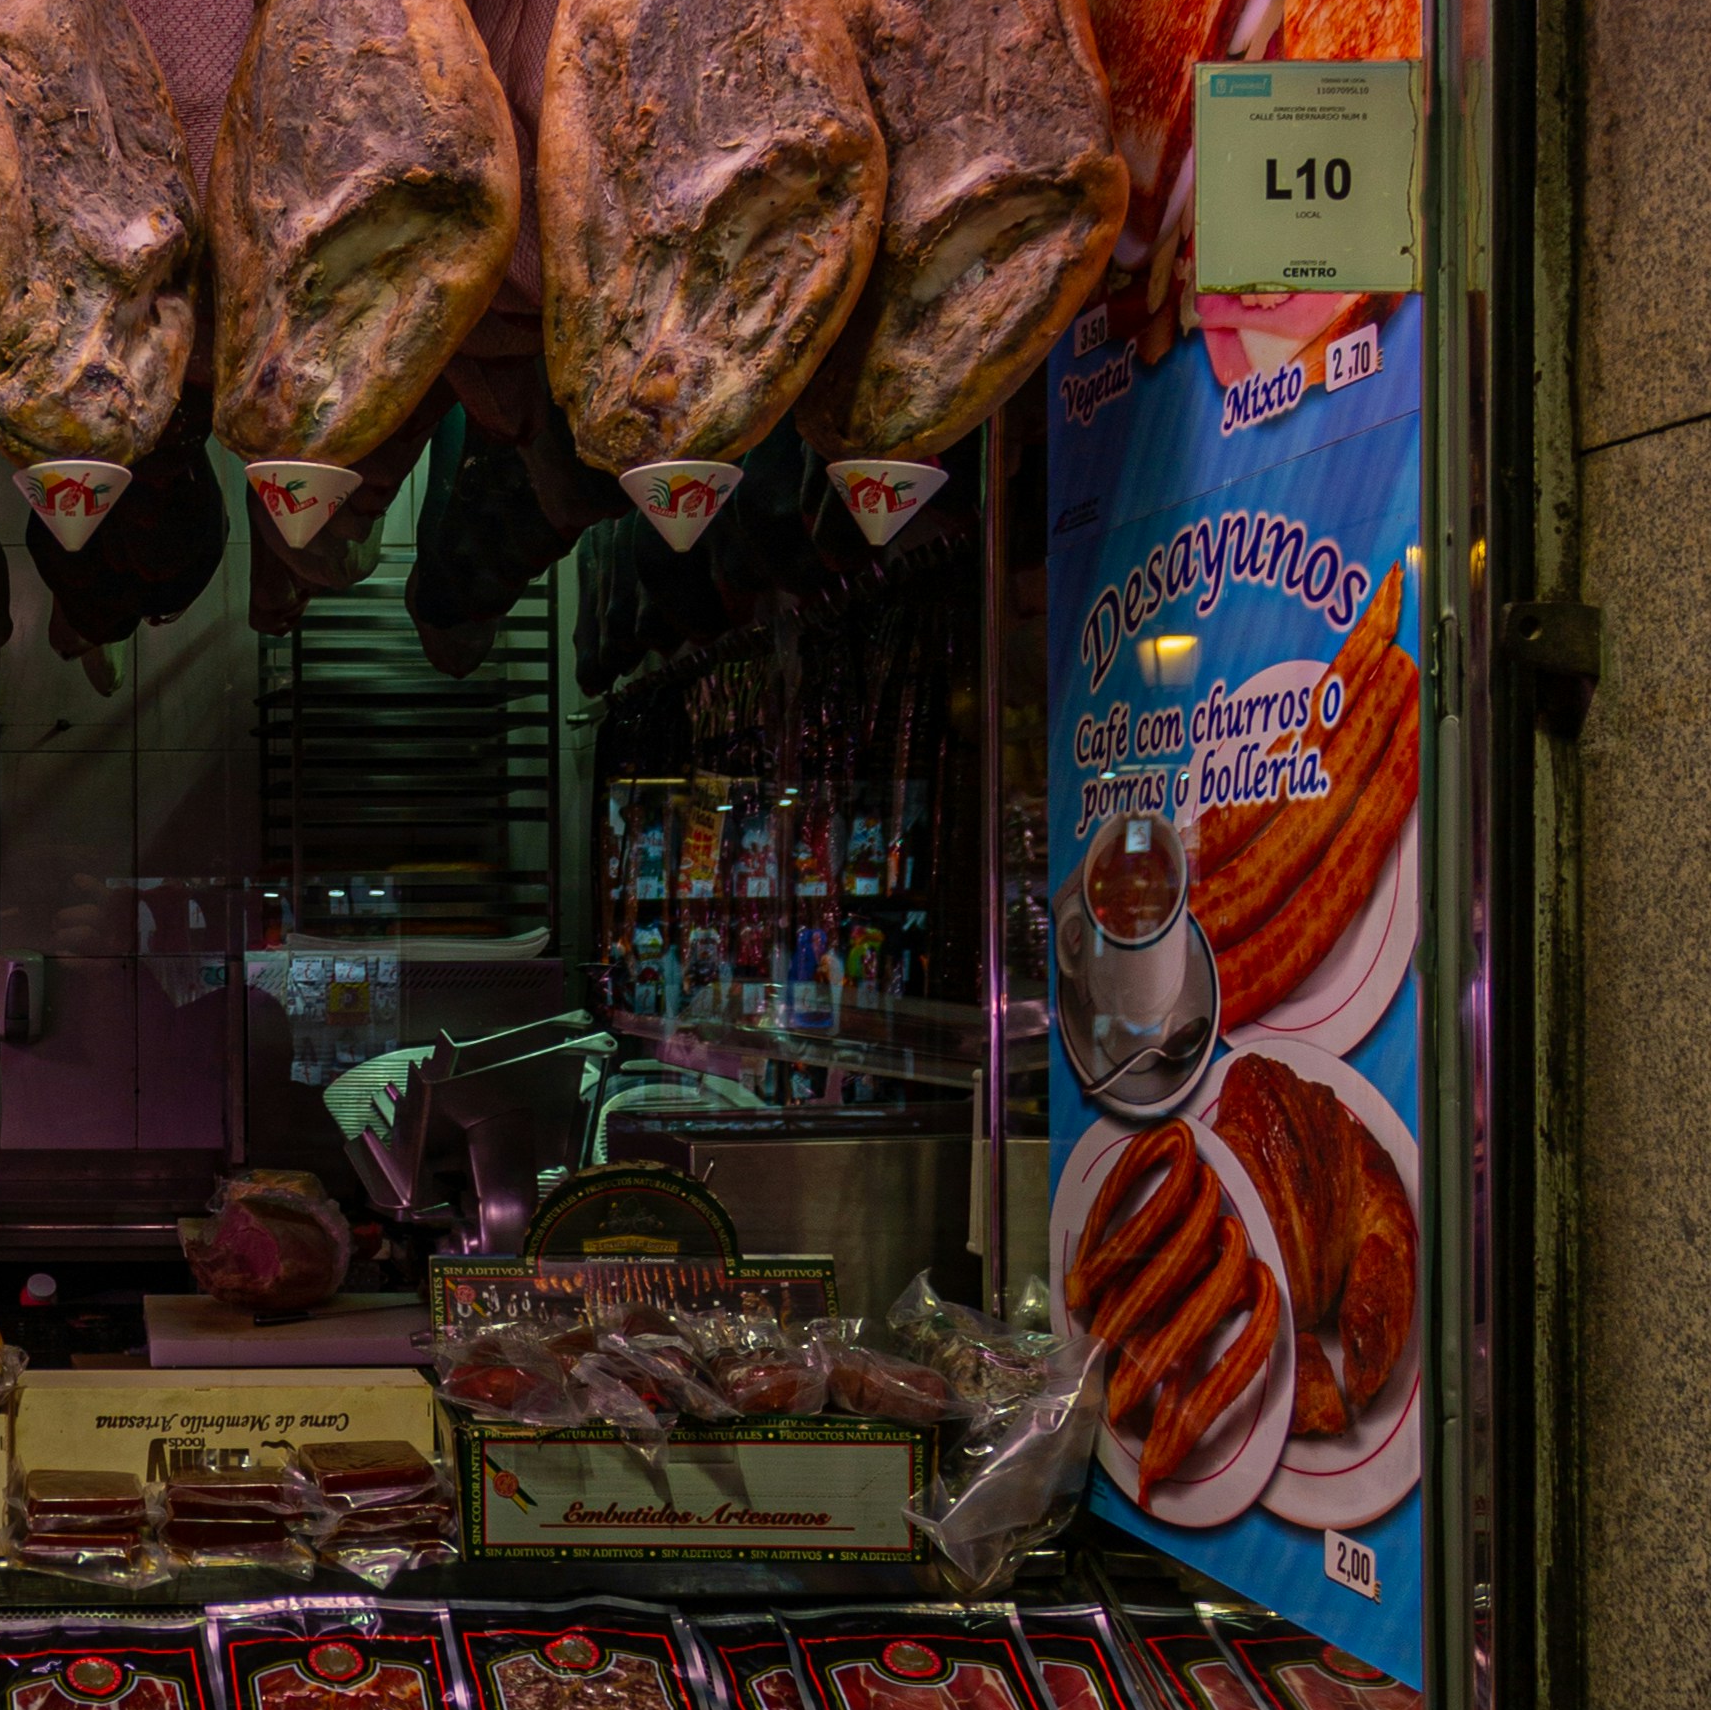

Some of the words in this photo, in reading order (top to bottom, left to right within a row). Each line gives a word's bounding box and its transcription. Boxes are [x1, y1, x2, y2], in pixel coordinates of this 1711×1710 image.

[1249, 113, 1275, 121] CALLE
[1275, 113, 1294, 121] SAN
[1295, 113, 1340, 121] BERNARDO
[1341, 113, 1361, 121] NUM
[1266, 157, 1352, 200] L10
[1295, 211, 1321, 219] LOCAL
[1282, 267, 1337, 278] CENTRO
[1332, 341, 1372, 381] 2,70
[1061, 341, 1134, 422] Vegetal
[1224, 365, 1303, 432] Mixto
[1083, 513, 1368, 689] Desayunos
[1076, 703, 1128, 773] Café
[1136, 712, 1183, 753] con
[1192, 680, 1310, 745] churros
[1322, 680, 1343, 724] o
[1077, 769, 1165, 836] porras
[443, 1267, 463, 1276] SIN
[465, 1267, 525, 1277] ADITIVOS
[95, 1412, 179, 1433] Artesana
[180, 1414, 270, 1435] Membrillo
[275, 1413, 295, 1434] de
[300, 1412, 350, 1432] Carne
[779, 1430, 845, 1442] PRODUCTOS
[846, 1431, 912, 1442] NATURALES
[471, 1441, 482, 1525] COLORANTES
[562, 1499, 694, 1525] Embutidos
[696, 1500, 833, 1526] Artesanos
[840, 1550, 859, 1561] SIN
[859, 1550, 913, 1562] ADITIVOS
[1335, 1539, 1372, 1587] 2,00
